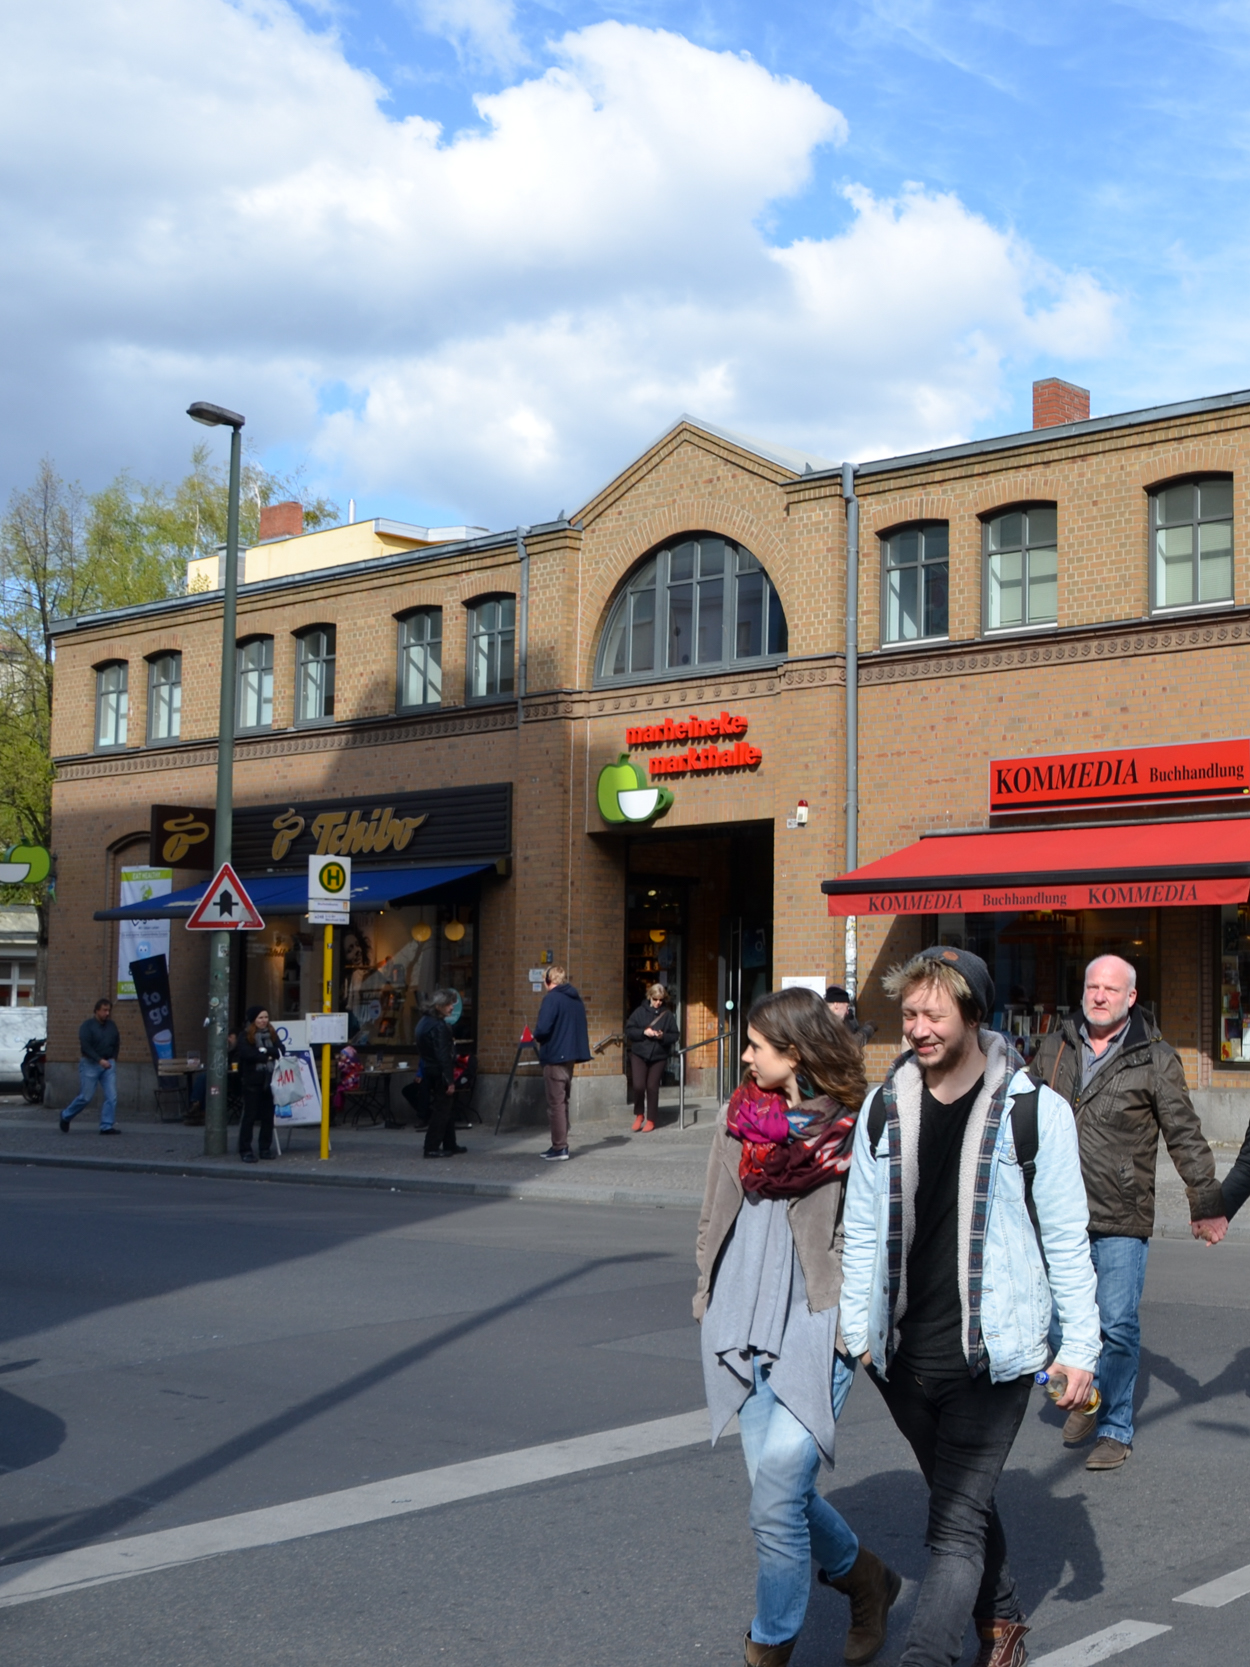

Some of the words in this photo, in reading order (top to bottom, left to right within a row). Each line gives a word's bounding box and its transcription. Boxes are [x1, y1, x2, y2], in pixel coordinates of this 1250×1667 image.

[626, 711, 748, 744] marheineke
[649, 742, 763, 774] markthalle
[995, 758, 1139, 795] KOMMEDIA
[1149, 763, 1245, 784] Buchhandlung
[311, 807, 429, 855] Tchibo
[327, 869, 340, 886] H
[868, 893, 963, 912] KOMMEDIA
[982, 891, 1067, 907] Buchhandlung
[1088, 884, 1199, 904] KOMMEDIA
[143, 992, 161, 1005] to
[149, 1005, 169, 1025] go
